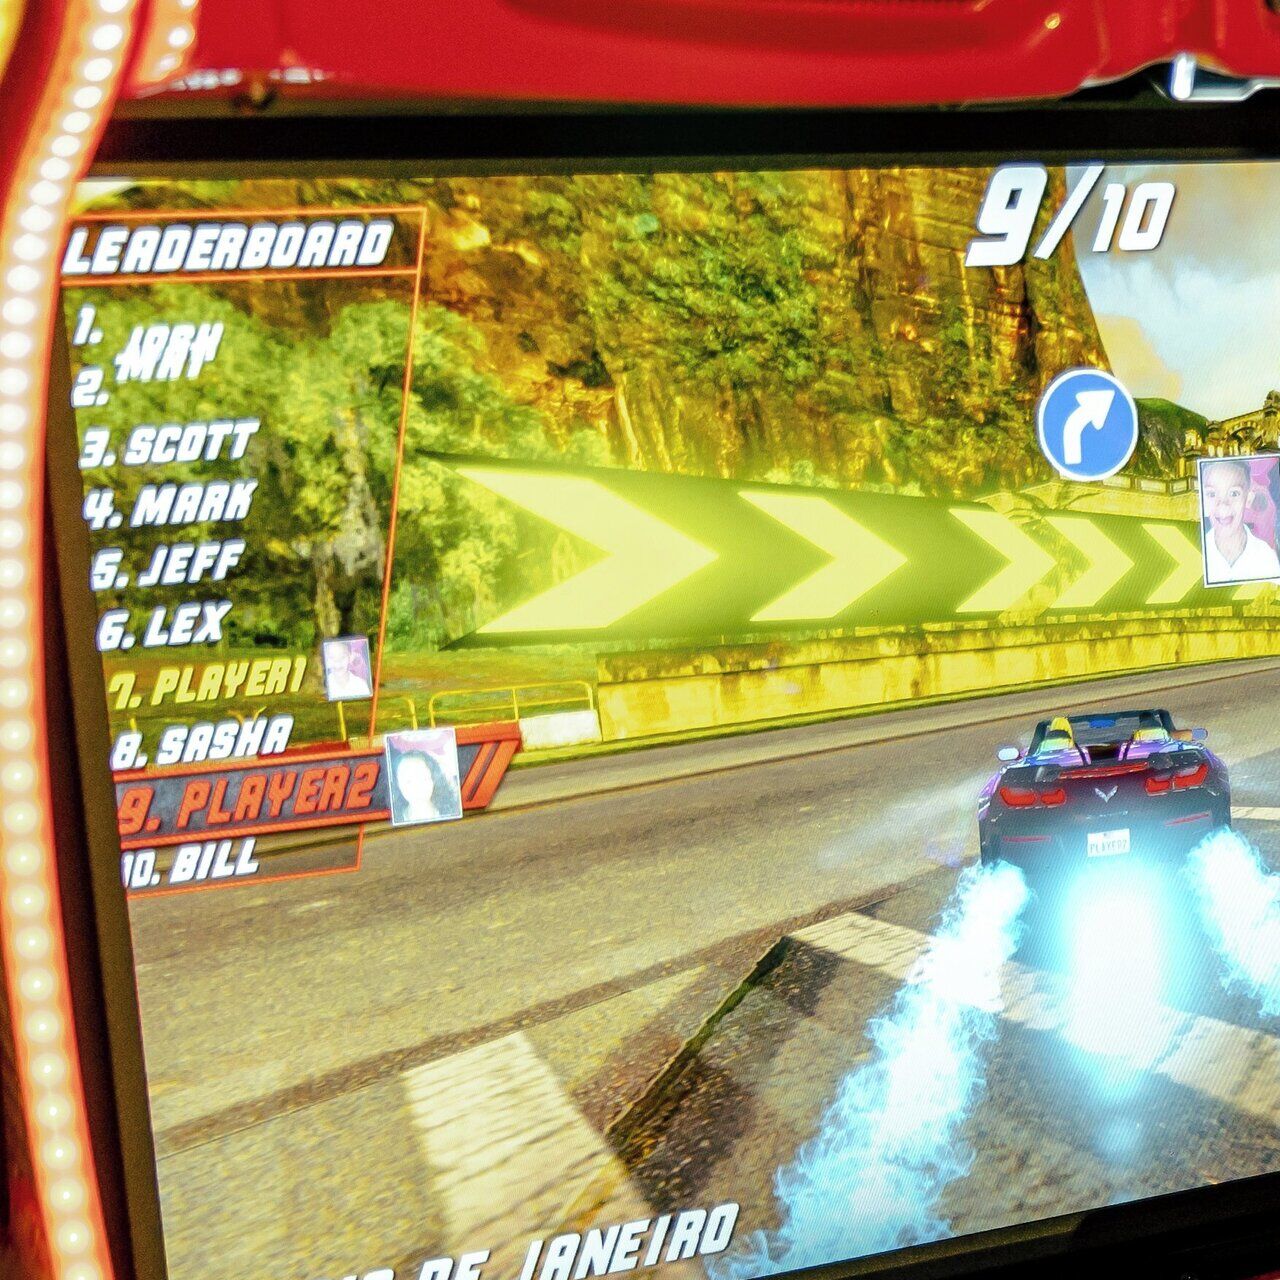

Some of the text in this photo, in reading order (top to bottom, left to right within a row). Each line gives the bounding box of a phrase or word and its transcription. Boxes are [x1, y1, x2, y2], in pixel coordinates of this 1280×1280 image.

[965, 162, 1176, 267] 9/10
[62, 220, 394, 275] LEADERBOARD
[74, 303, 102, 346] 1.
[71, 366, 109, 408] 2.
[78, 418, 260, 469] 3. SCOTT
[82, 478, 259, 530] 4. MARK
[90, 540, 246, 592] 5. JEFF
[97, 600, 233, 651] 6. LEX
[109, 657, 307, 710] 7. PLAYER1
[111, 714, 295, 770] 8. SASHA
[119, 762, 380, 834] 9. PLAYER2
[122, 837, 259, 889] 10. BILL
